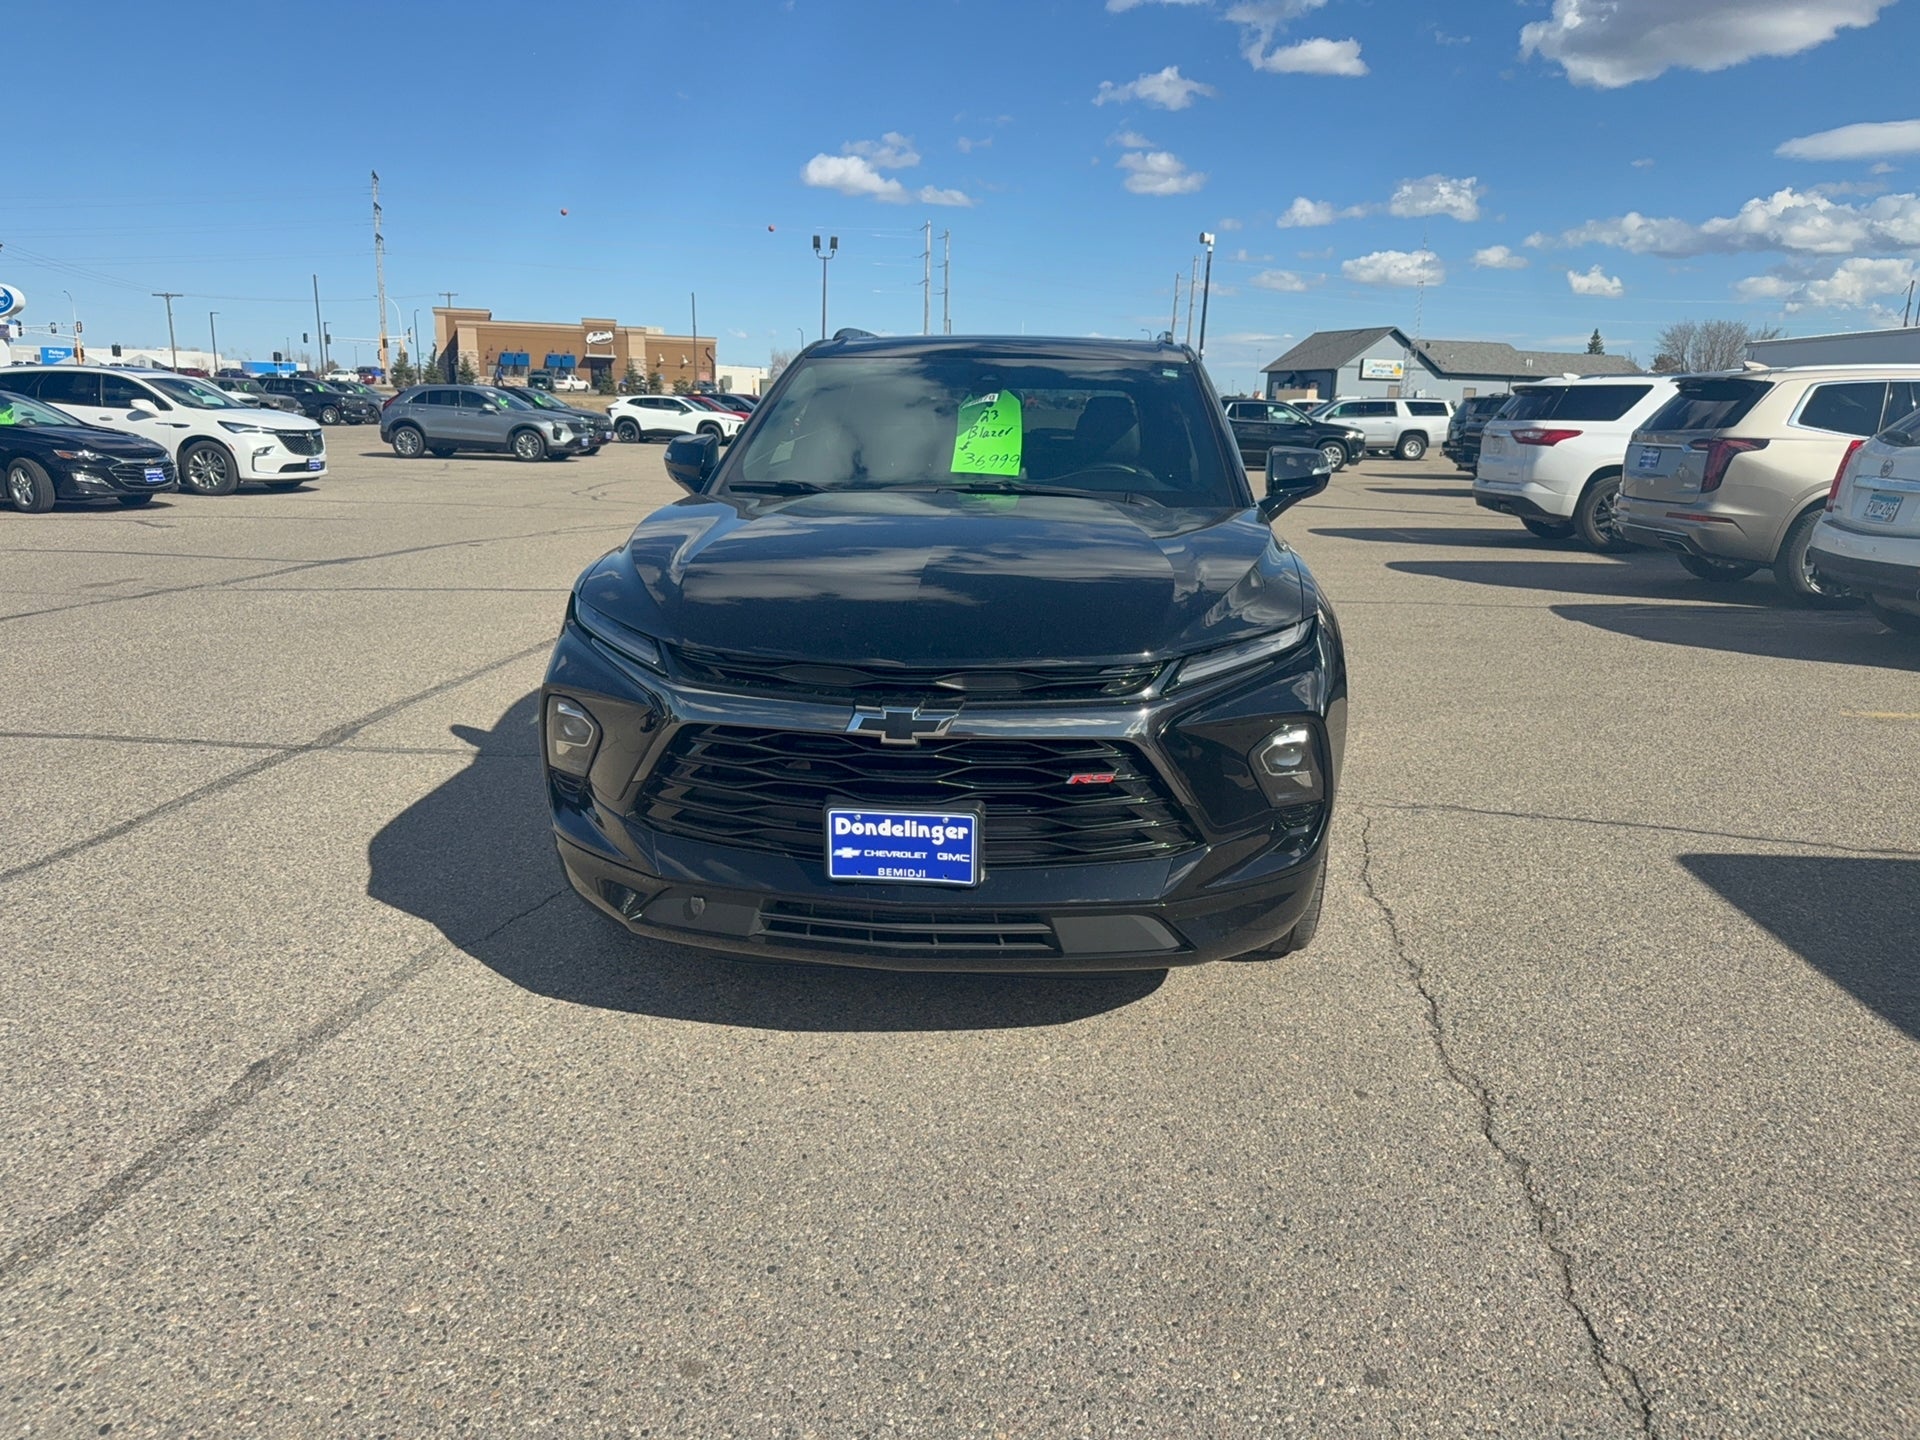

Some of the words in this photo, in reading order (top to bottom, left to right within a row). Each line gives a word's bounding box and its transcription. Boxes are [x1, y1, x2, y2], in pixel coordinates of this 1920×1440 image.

[980, 409, 999, 423] 23
[968, 425, 1014, 439] Blazer
[1066, 772, 1116, 785] RS
[834, 816, 969, 846] Dondelinger
[863, 849, 928, 860] CHEVROLET
[937, 852, 970, 863] GMC
[877, 867, 927, 878] BEMIDJI
